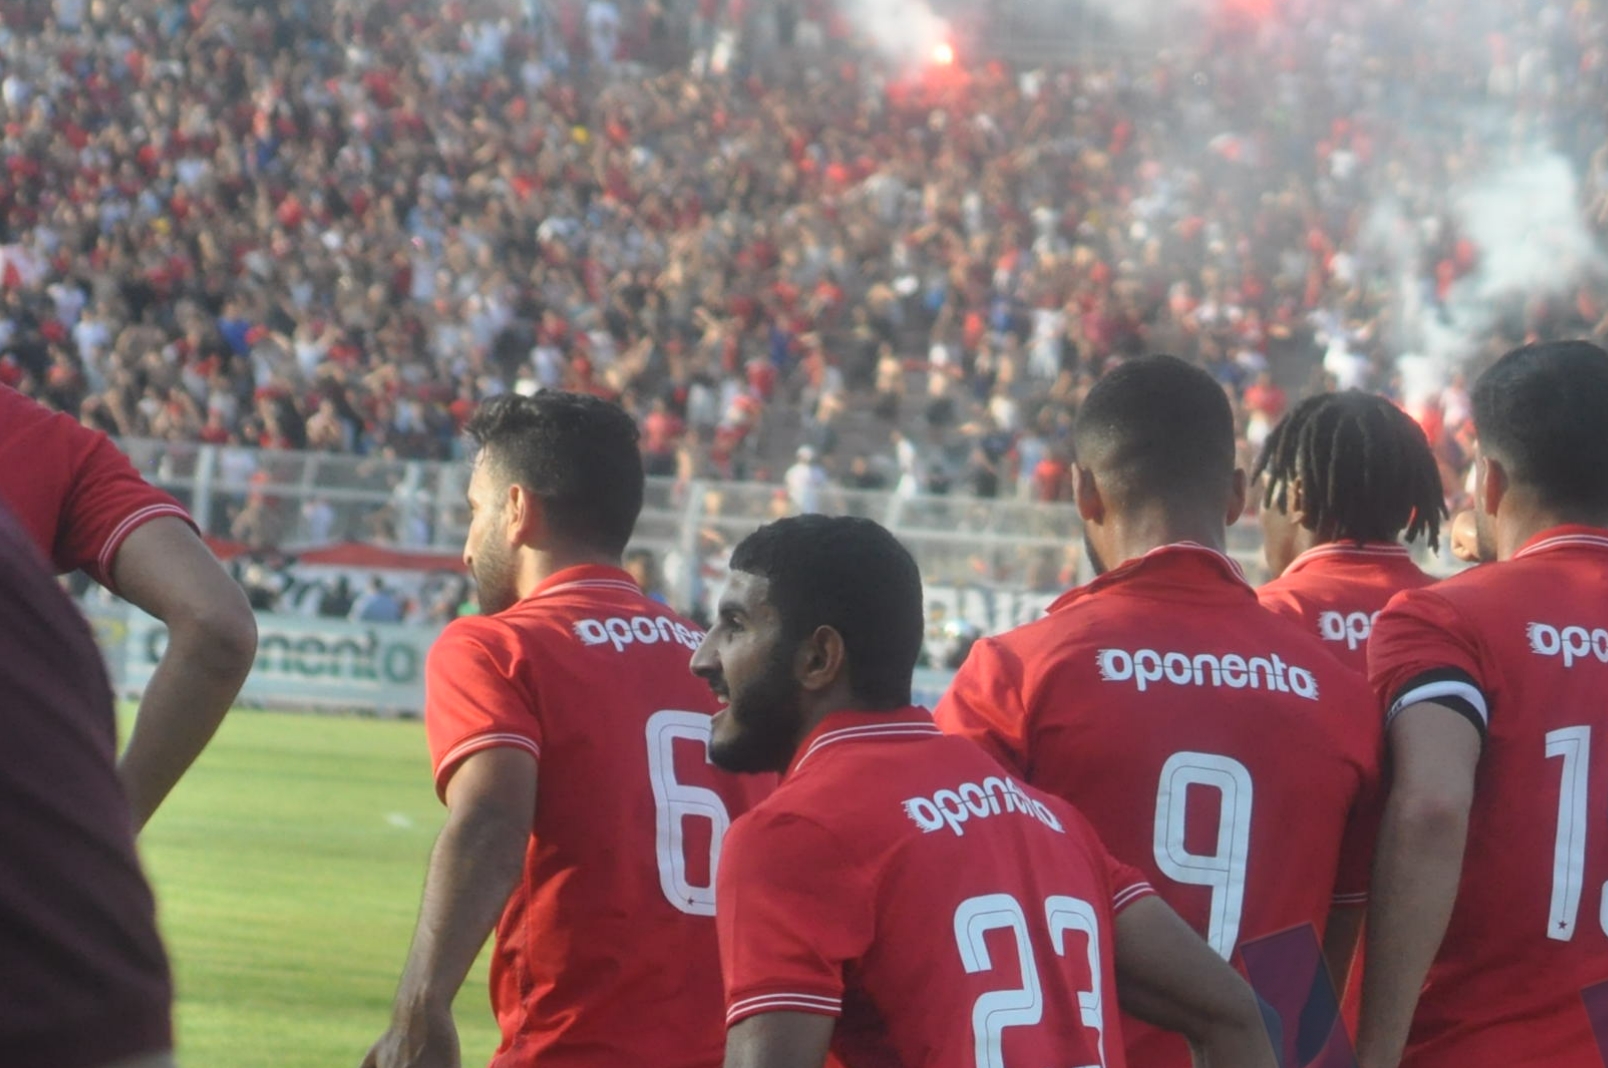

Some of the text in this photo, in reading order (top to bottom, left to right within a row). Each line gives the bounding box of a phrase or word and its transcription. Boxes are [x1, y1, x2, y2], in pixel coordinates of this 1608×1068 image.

[572, 616, 707, 652] opone
[1095, 648, 1318, 700] oponento
[645, 710, 731, 916] 6
[1153, 751, 1253, 962] 9
